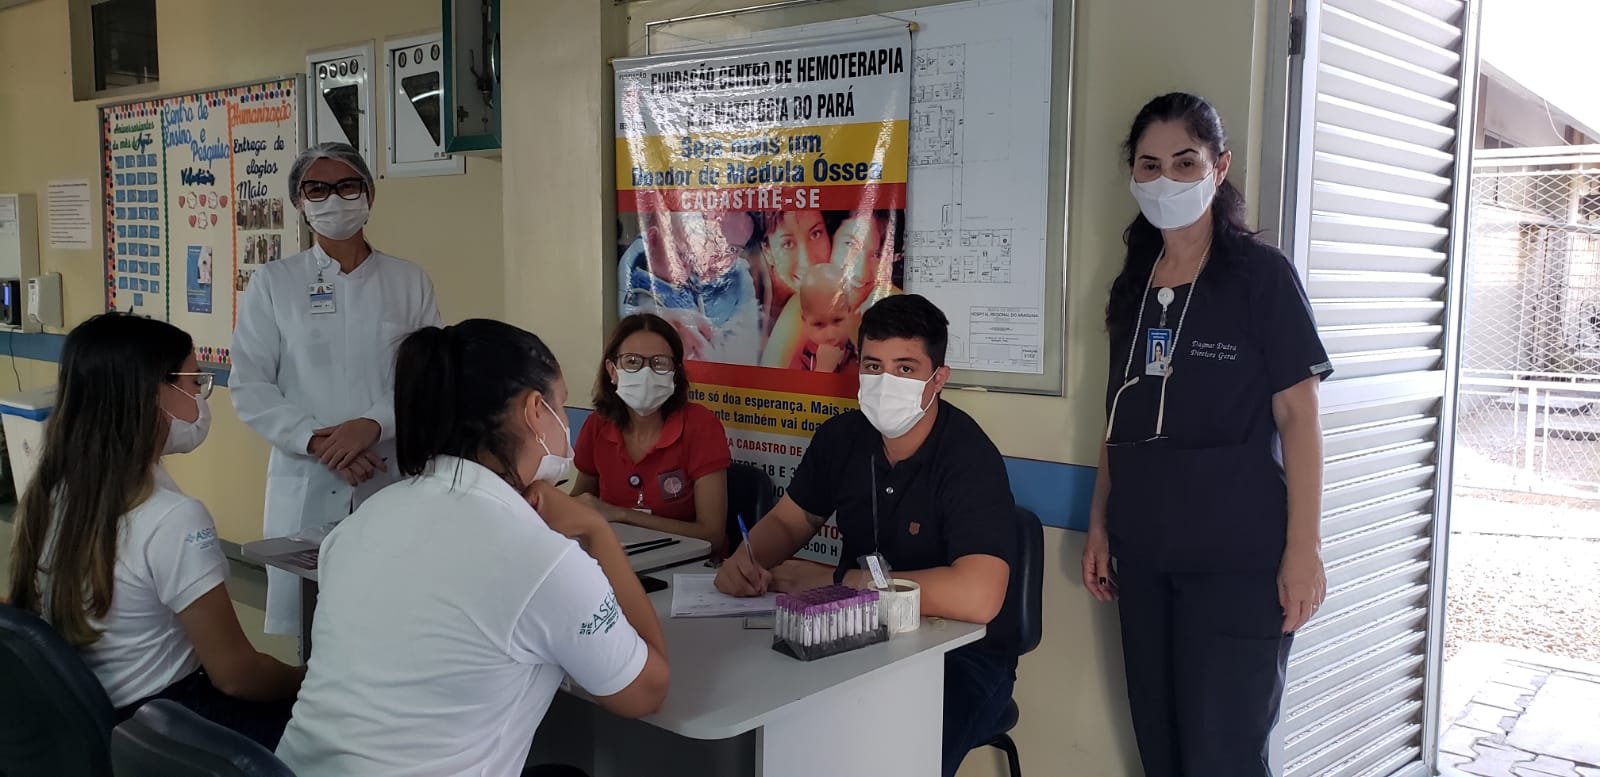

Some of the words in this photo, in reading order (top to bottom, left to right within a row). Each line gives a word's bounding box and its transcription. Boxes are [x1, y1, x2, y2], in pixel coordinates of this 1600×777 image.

[651, 63, 714, 95] FUNDAÇÃO
[720, 62, 769, 89] CENTRO
[775, 60, 792, 84] DE
[798, 47, 903, 82] HEMOTERAPIA
[794, 94, 812, 119] DO
[818, 85, 854, 118] PARÁ
[234, 137, 267, 156] Entrega
[273, 135, 285, 150] de
[681, 136, 722, 162] Seja
[731, 137, 780, 155] mais
[789, 134, 820, 153] um
[246, 159, 278, 178] elogios
[632, 166, 692, 186] Doador
[699, 165, 719, 185] de
[726, 160, 804, 185] Medula
[814, 153, 882, 181] Óssea
[237, 180, 268, 200] Maio
[681, 188, 820, 209] CADASTRE-SE
[688, 389, 705, 401] nte
[722, 392, 741, 405] doa
[745, 396, 807, 414] esperança.
[811, 401, 840, 416] Mais
[734, 411, 777, 427] também
[781, 417, 797, 429] vai
[737, 439, 786, 454] CADASTRO
[790, 446, 802, 456] DE
[762, 464, 775, 476] 18
[779, 466, 785, 478] E
[831, 545, 838, 557] H
